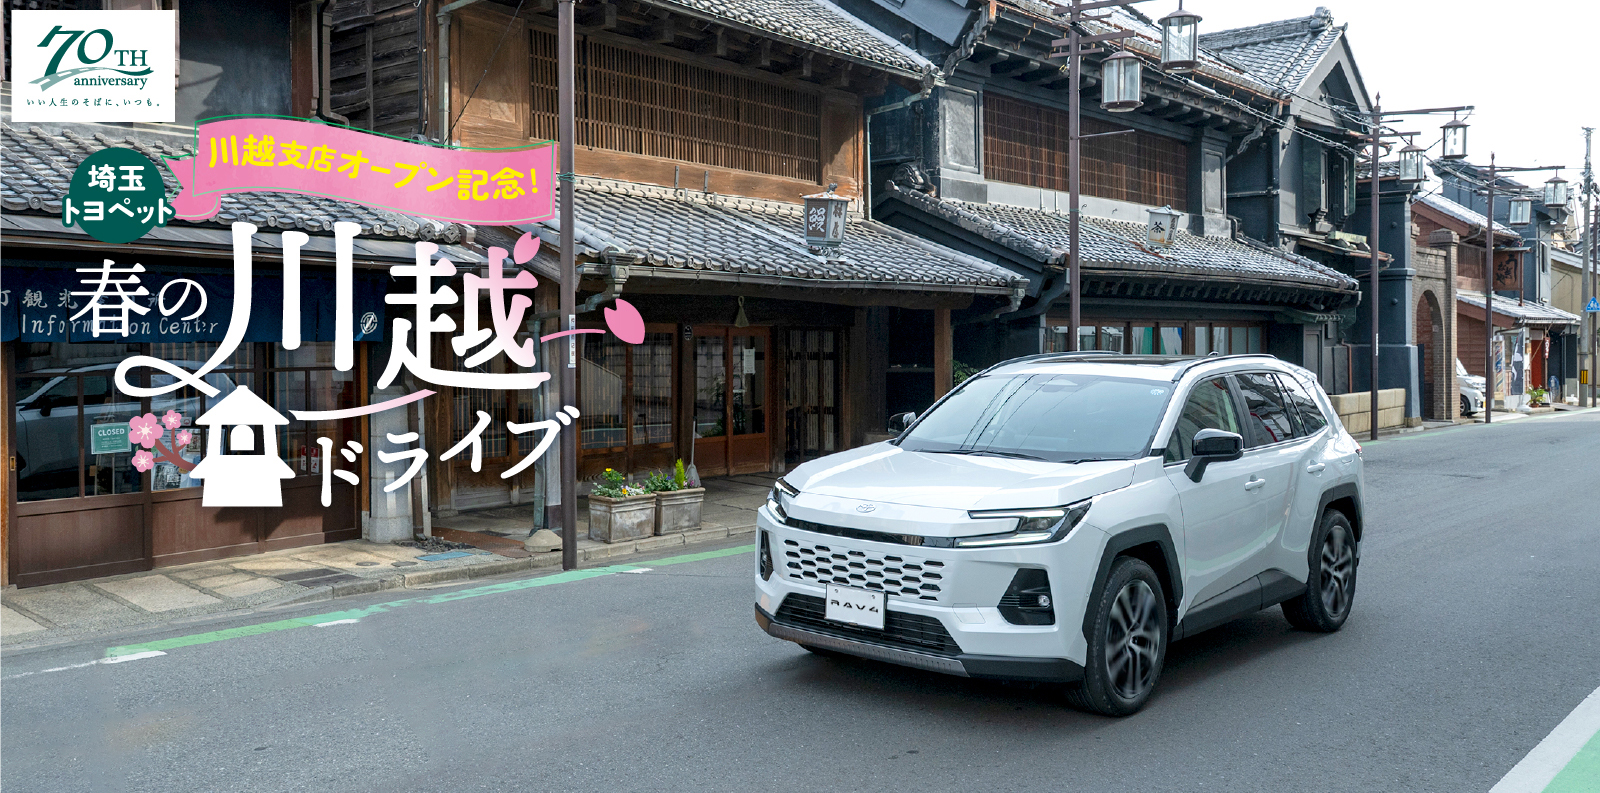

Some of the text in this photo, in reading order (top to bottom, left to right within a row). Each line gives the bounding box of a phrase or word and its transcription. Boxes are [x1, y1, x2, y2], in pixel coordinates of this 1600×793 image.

[1150, 221, 1165, 233] 茶
[97, 428, 125, 437] CLOSED
[831, 599, 879, 614] RAV4
